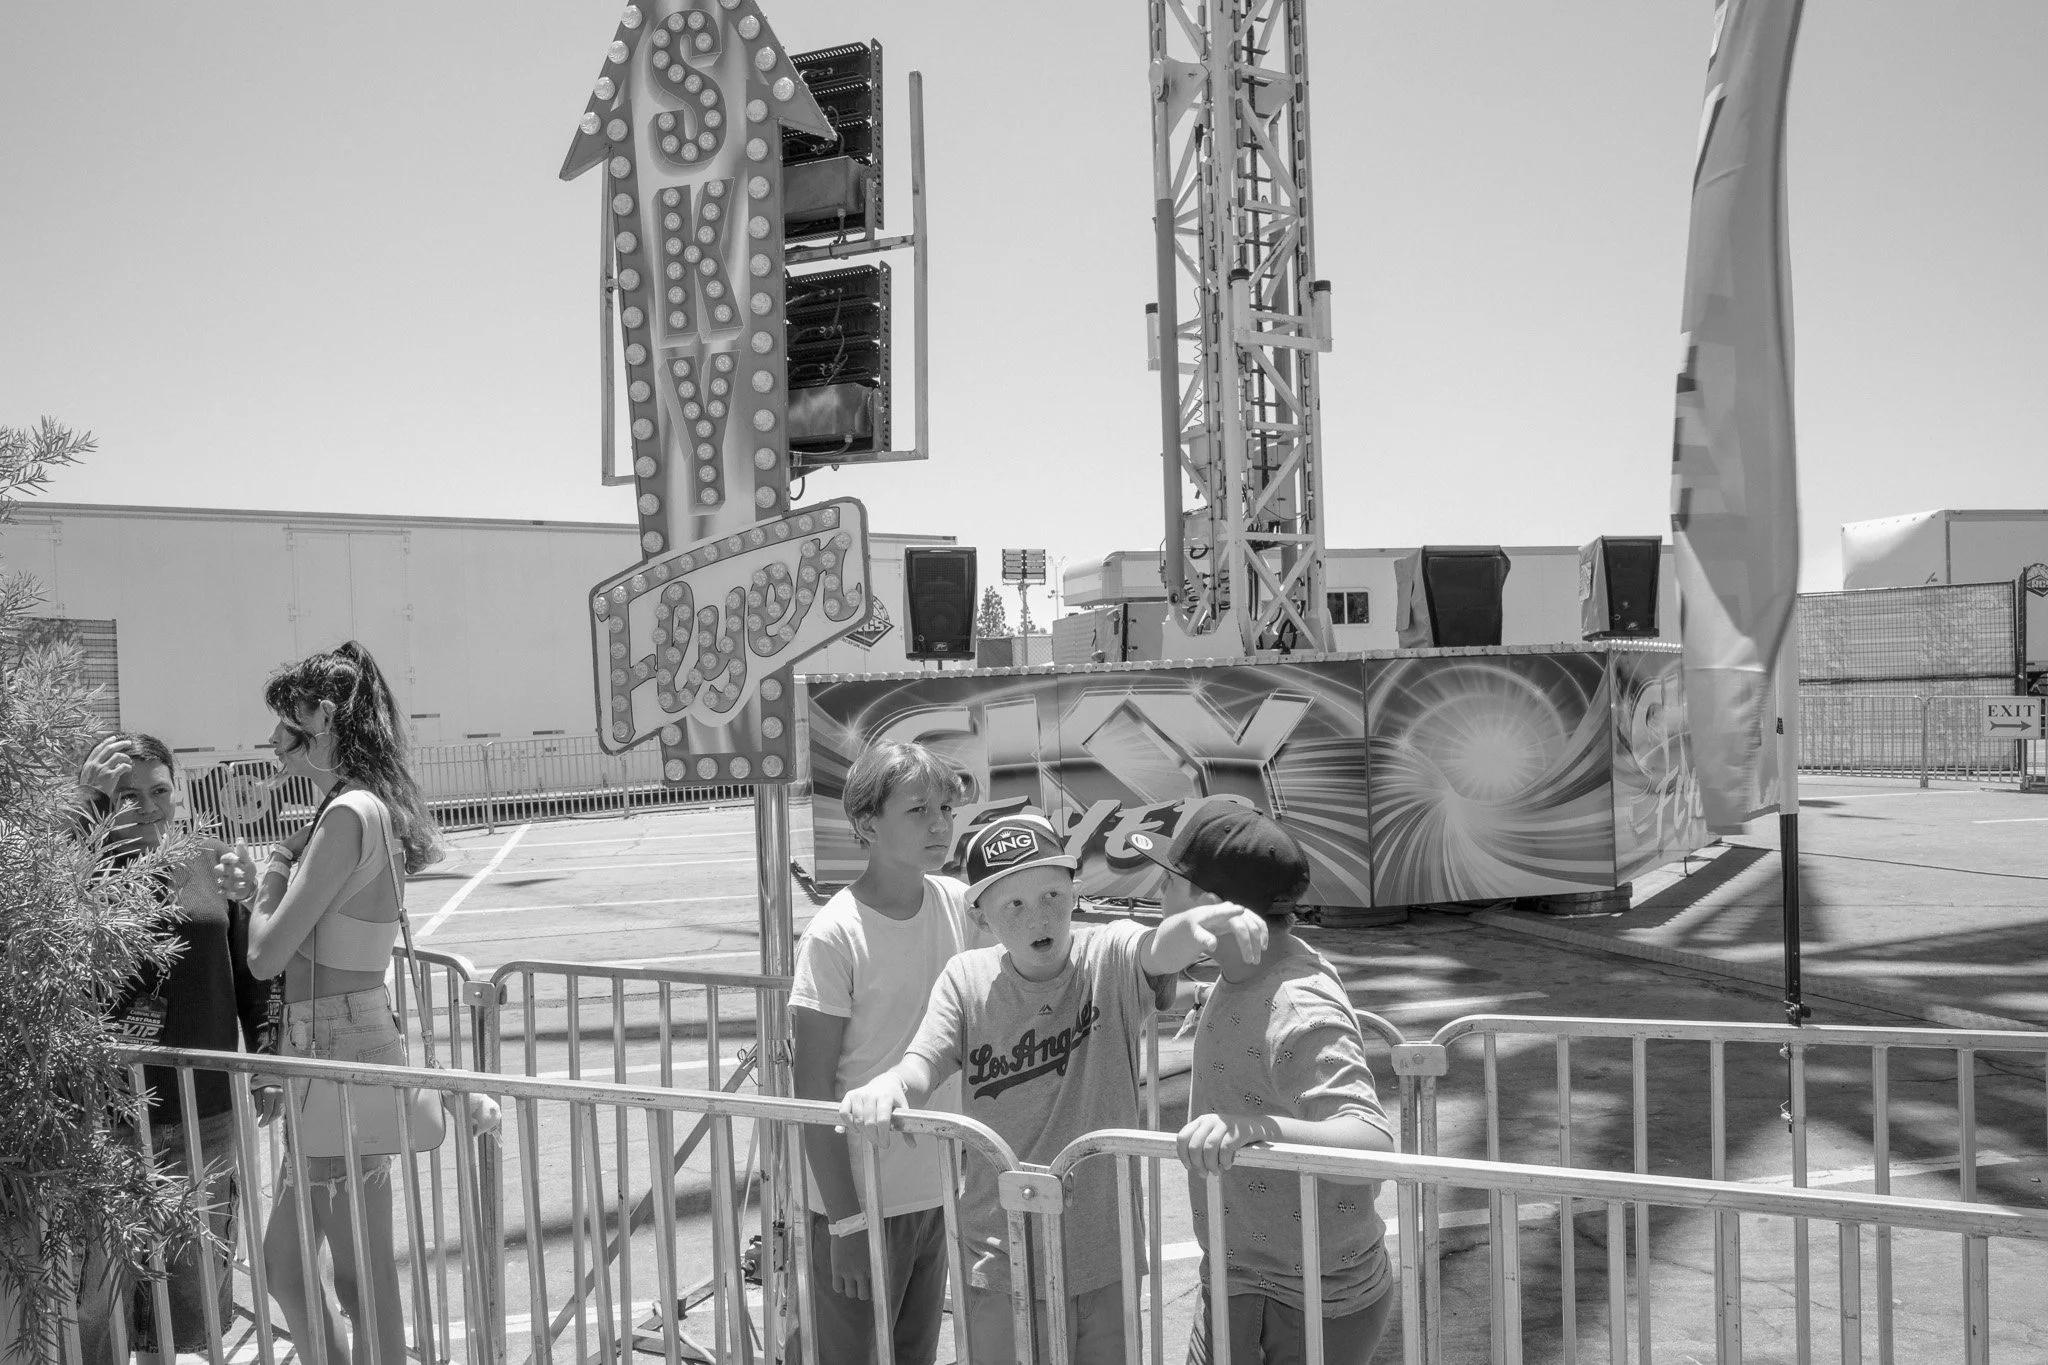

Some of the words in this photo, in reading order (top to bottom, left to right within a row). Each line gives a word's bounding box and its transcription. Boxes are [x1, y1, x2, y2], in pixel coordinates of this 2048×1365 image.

[651, 8, 744, 509] SKY
[1988, 704, 2035, 718] EXIT
[985, 834, 1032, 859] KING
[122, 1023, 160, 1037] VIP
[968, 1044, 1010, 1085] Los
